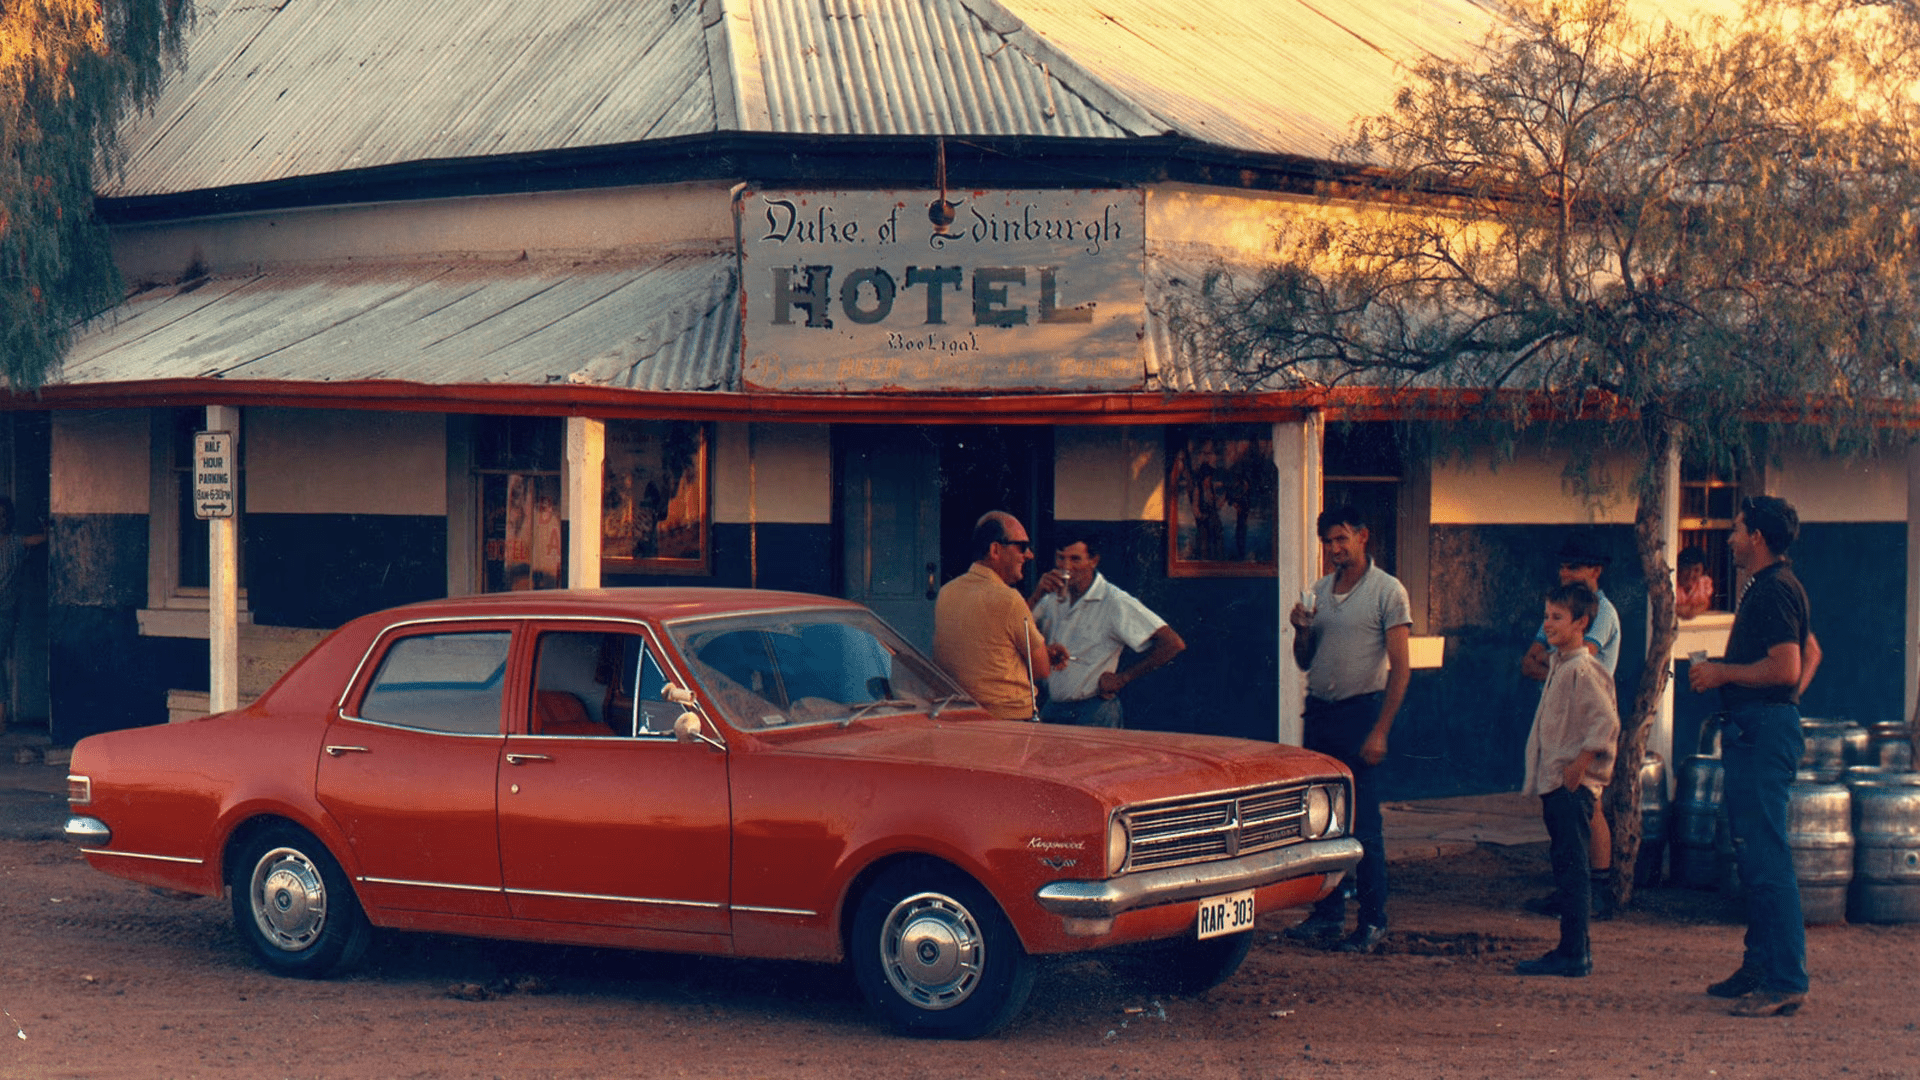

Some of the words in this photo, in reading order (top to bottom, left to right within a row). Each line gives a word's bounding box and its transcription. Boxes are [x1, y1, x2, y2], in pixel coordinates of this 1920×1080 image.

[878, 206, 900, 245] of
[769, 264, 1097, 329] HOTEL
[837, 357, 903, 379] BEER
[205, 441, 221, 453] HALF
[203, 457, 223, 468] HOUR
[199, 473, 228, 485] PARKING
